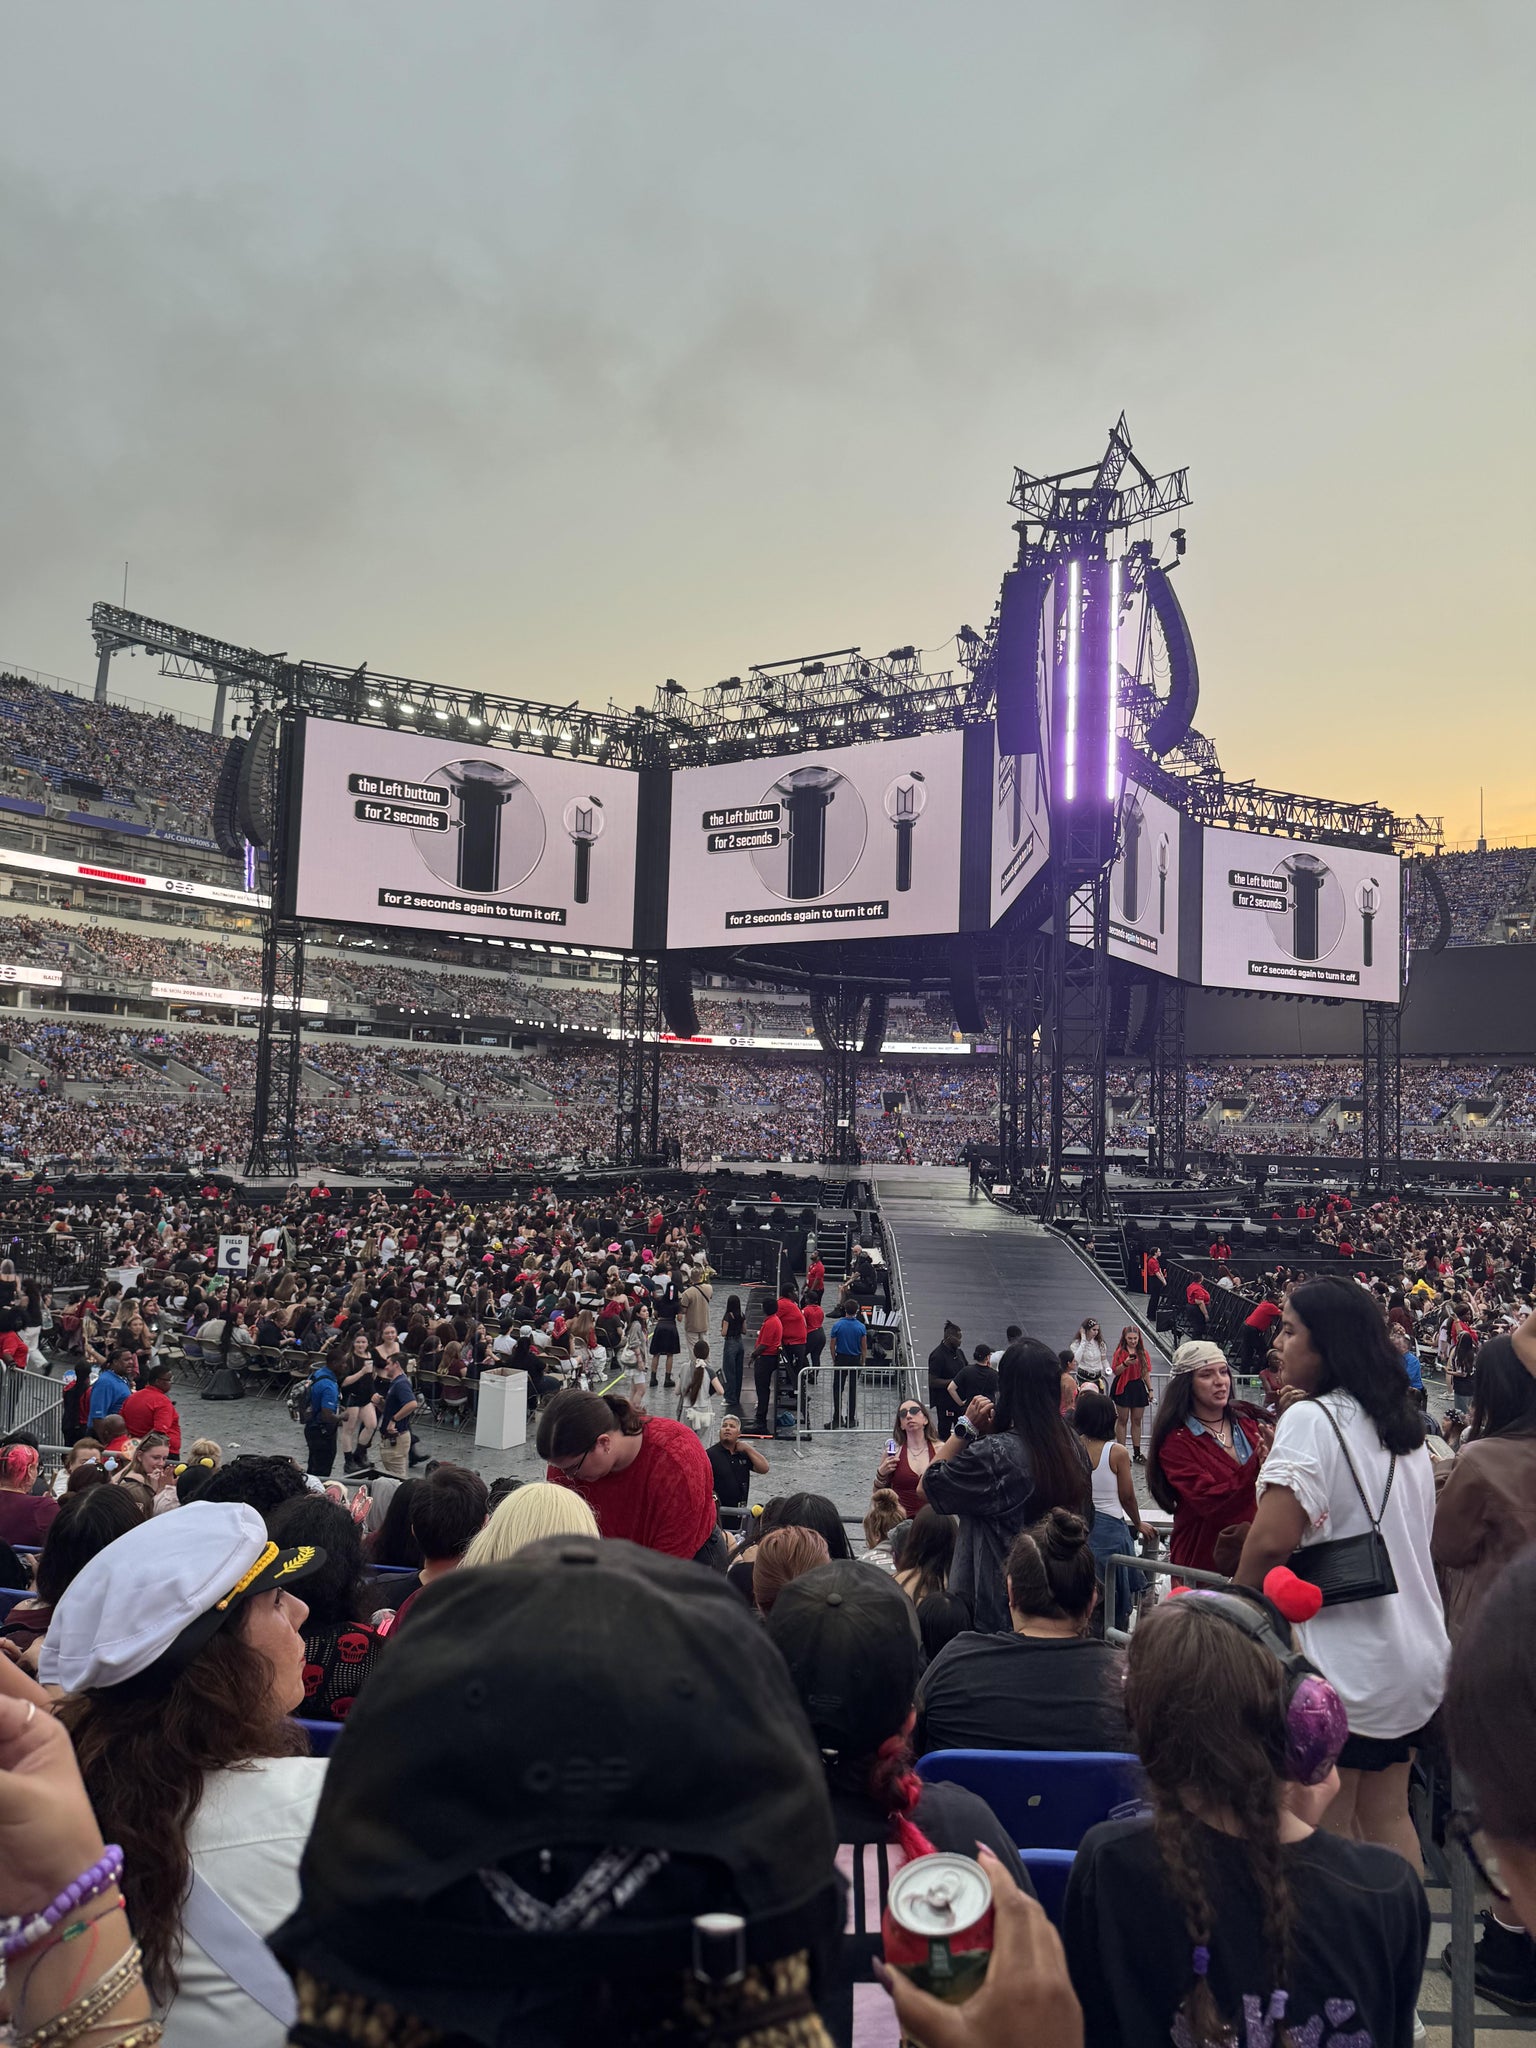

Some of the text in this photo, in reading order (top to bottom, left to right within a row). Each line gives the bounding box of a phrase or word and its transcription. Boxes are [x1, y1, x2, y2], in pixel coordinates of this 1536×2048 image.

[358, 778, 440, 803] the Left button
[364, 804, 439, 827] for 2 seconds
[710, 809, 773, 826] the Left button
[163, 832, 176, 840] AFC
[176, 835, 210, 848] CHAMPIONS
[714, 831, 773, 849] for 2 seconds
[1234, 873, 1283, 889] the Left button
[384, 892, 562, 921] for 2 seconds again to turn it off.
[1238, 893, 1282, 909] for 2 seconds
[730, 904, 884, 925] for 2 seconds again to turn it off.
[1251, 963, 1357, 982] for 2 seconds again to turn it off.
[225, 1247, 241, 1266] C
